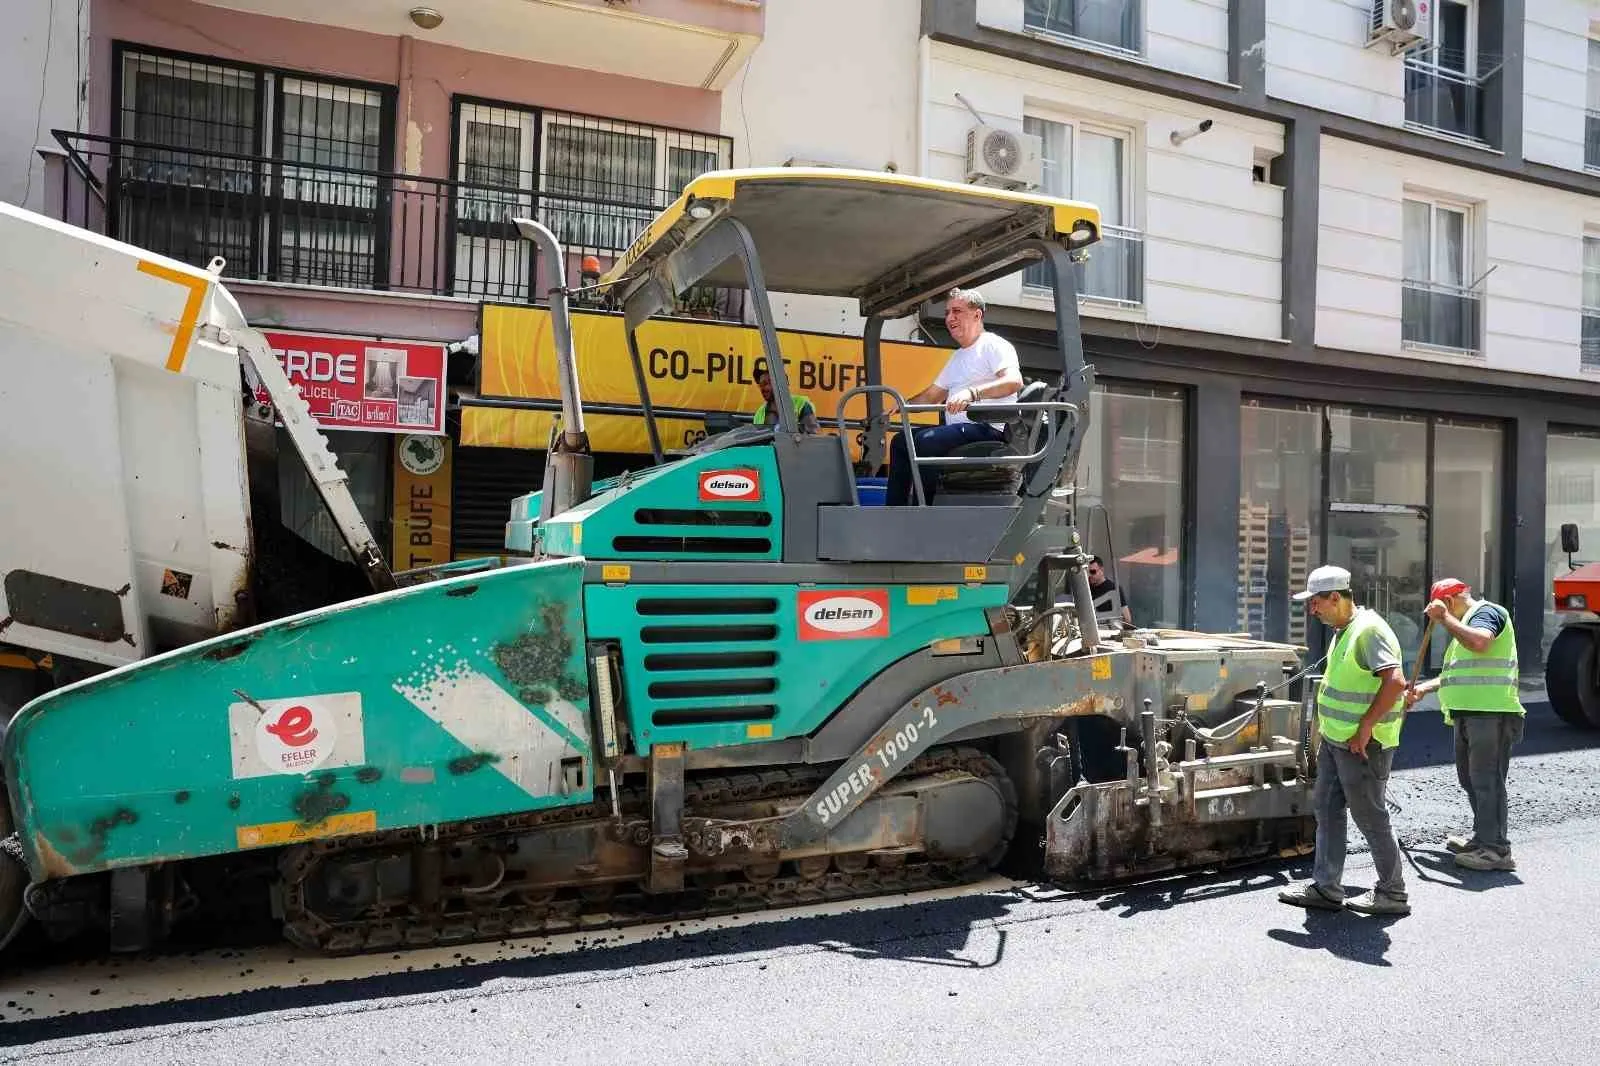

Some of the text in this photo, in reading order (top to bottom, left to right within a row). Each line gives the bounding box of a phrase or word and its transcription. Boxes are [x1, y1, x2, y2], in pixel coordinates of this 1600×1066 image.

[709, 480, 749, 489] delsan
[404, 484, 433, 546] BÜFE
[814, 607, 874, 620] delsan
[281, 749, 317, 762] EFELER
[816, 706, 938, 823] SUPER 1900-2
